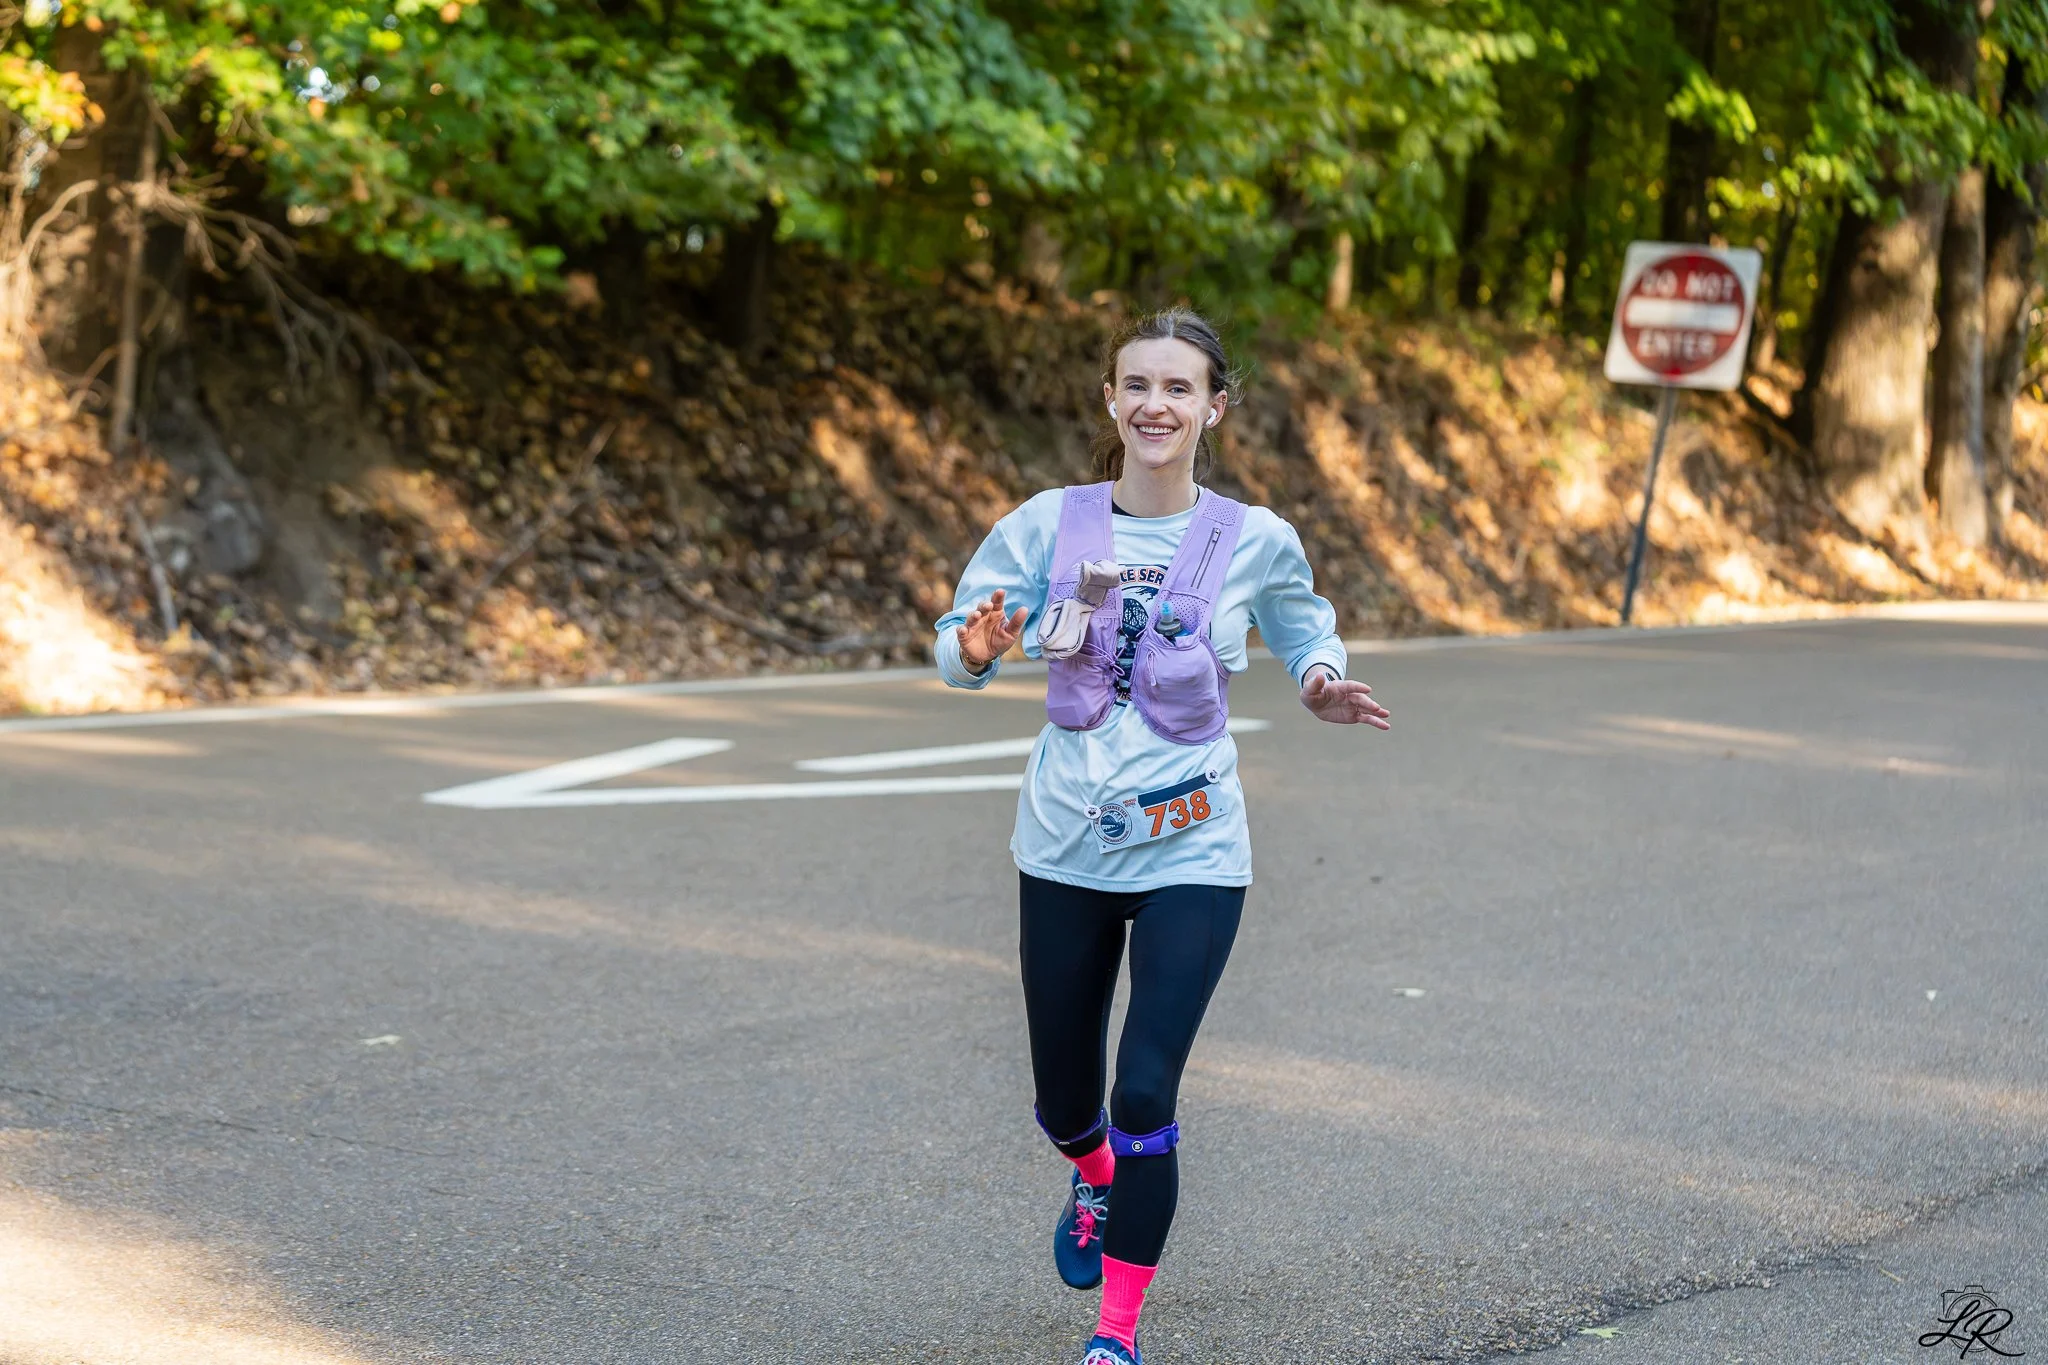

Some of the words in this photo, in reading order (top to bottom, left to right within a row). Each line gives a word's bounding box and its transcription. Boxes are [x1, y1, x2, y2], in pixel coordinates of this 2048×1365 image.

[1640, 268, 1678, 297] DO
[1685, 271, 1735, 302] NOT
[1637, 328, 1717, 361] ENTER
[1144, 790, 1211, 837] 738
